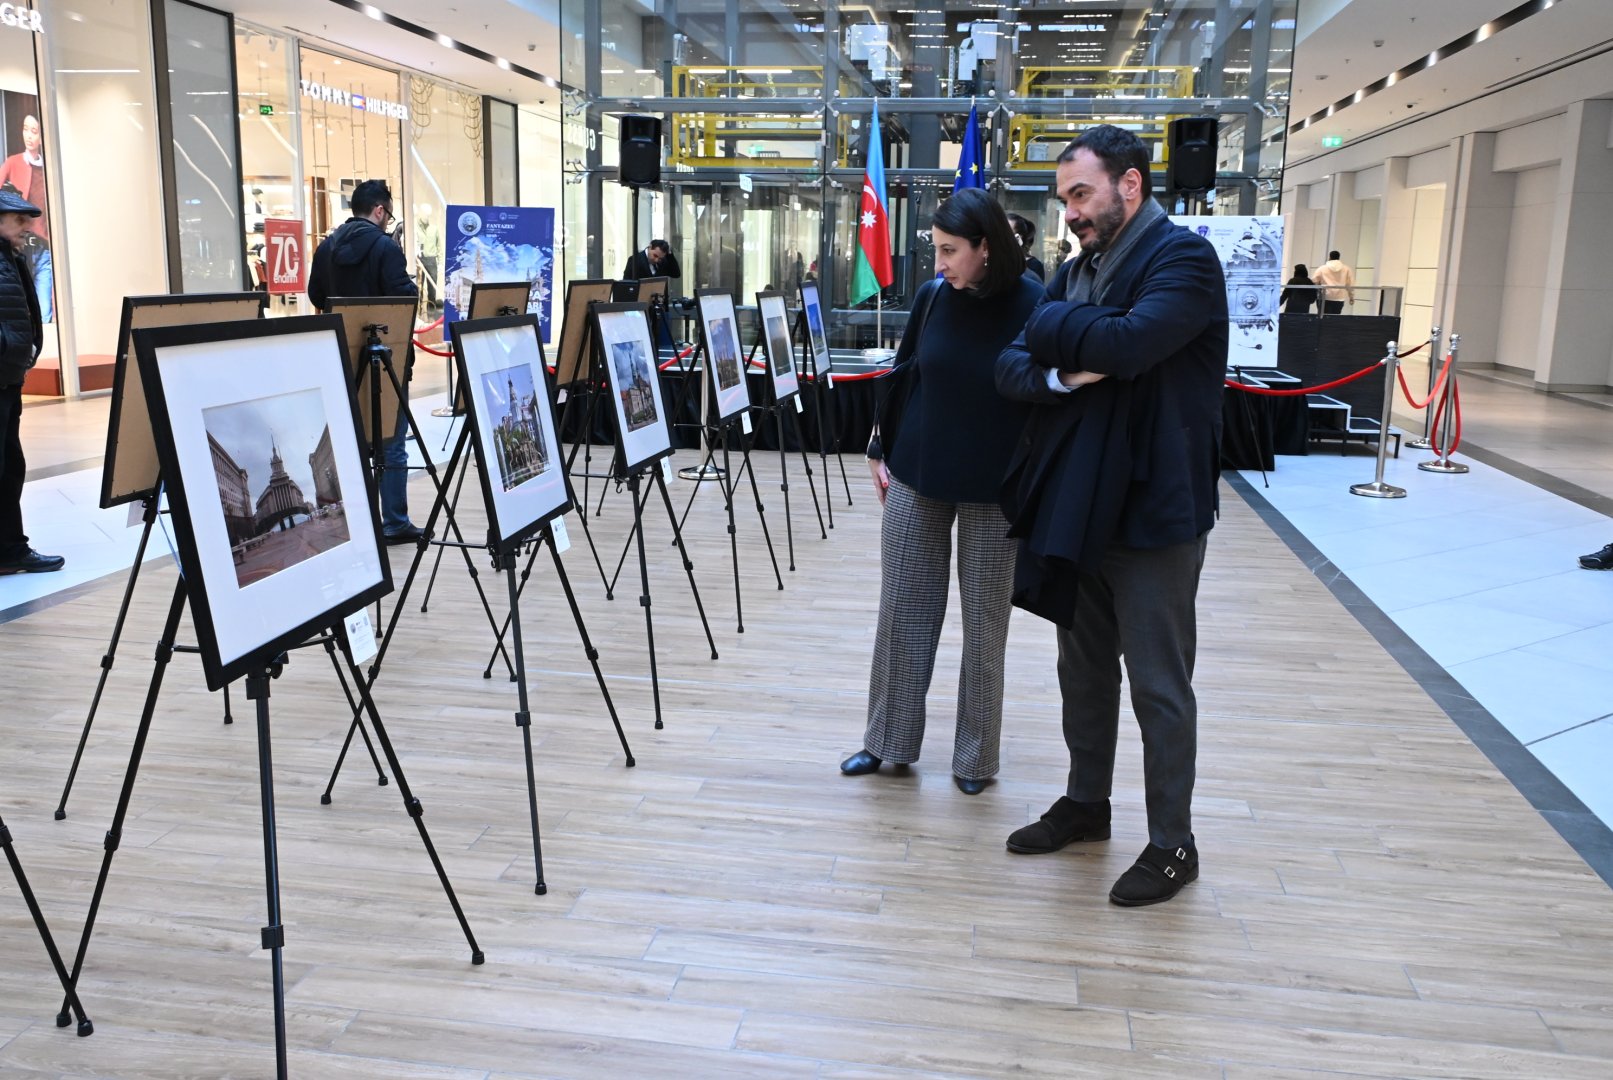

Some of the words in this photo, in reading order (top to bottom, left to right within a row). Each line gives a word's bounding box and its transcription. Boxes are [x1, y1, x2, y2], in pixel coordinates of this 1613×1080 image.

[0, 3, 45, 33] GER
[301, 80, 352, 107] TOMMY
[366, 97, 408, 120] HILFIGER
